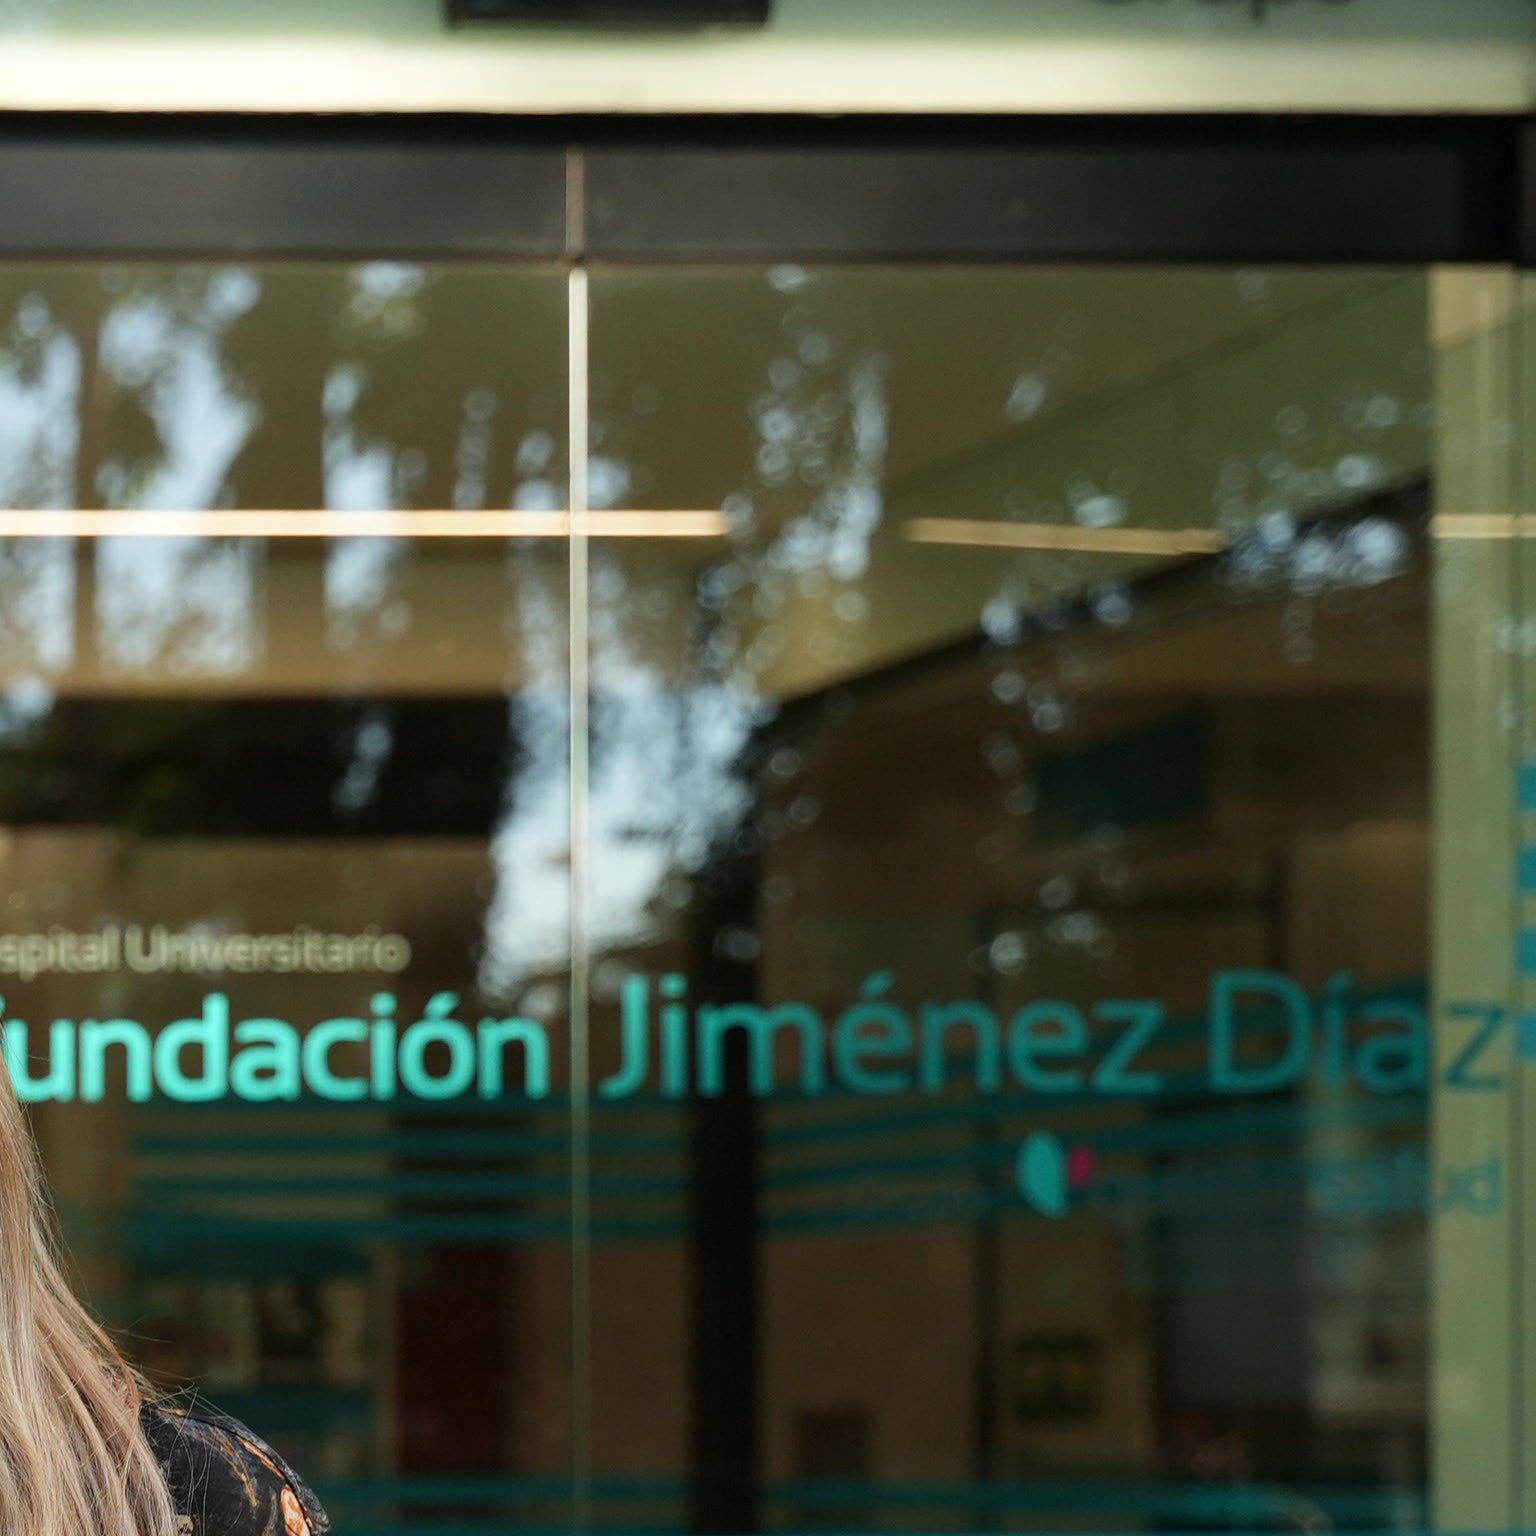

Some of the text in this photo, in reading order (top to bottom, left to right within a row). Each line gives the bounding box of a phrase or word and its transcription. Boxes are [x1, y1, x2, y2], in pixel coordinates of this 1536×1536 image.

[126, 925, 413, 973] Universitario
[600, 971, 1165, 1100] Jiménez
[1209, 968, 1508, 1093] Díaz
